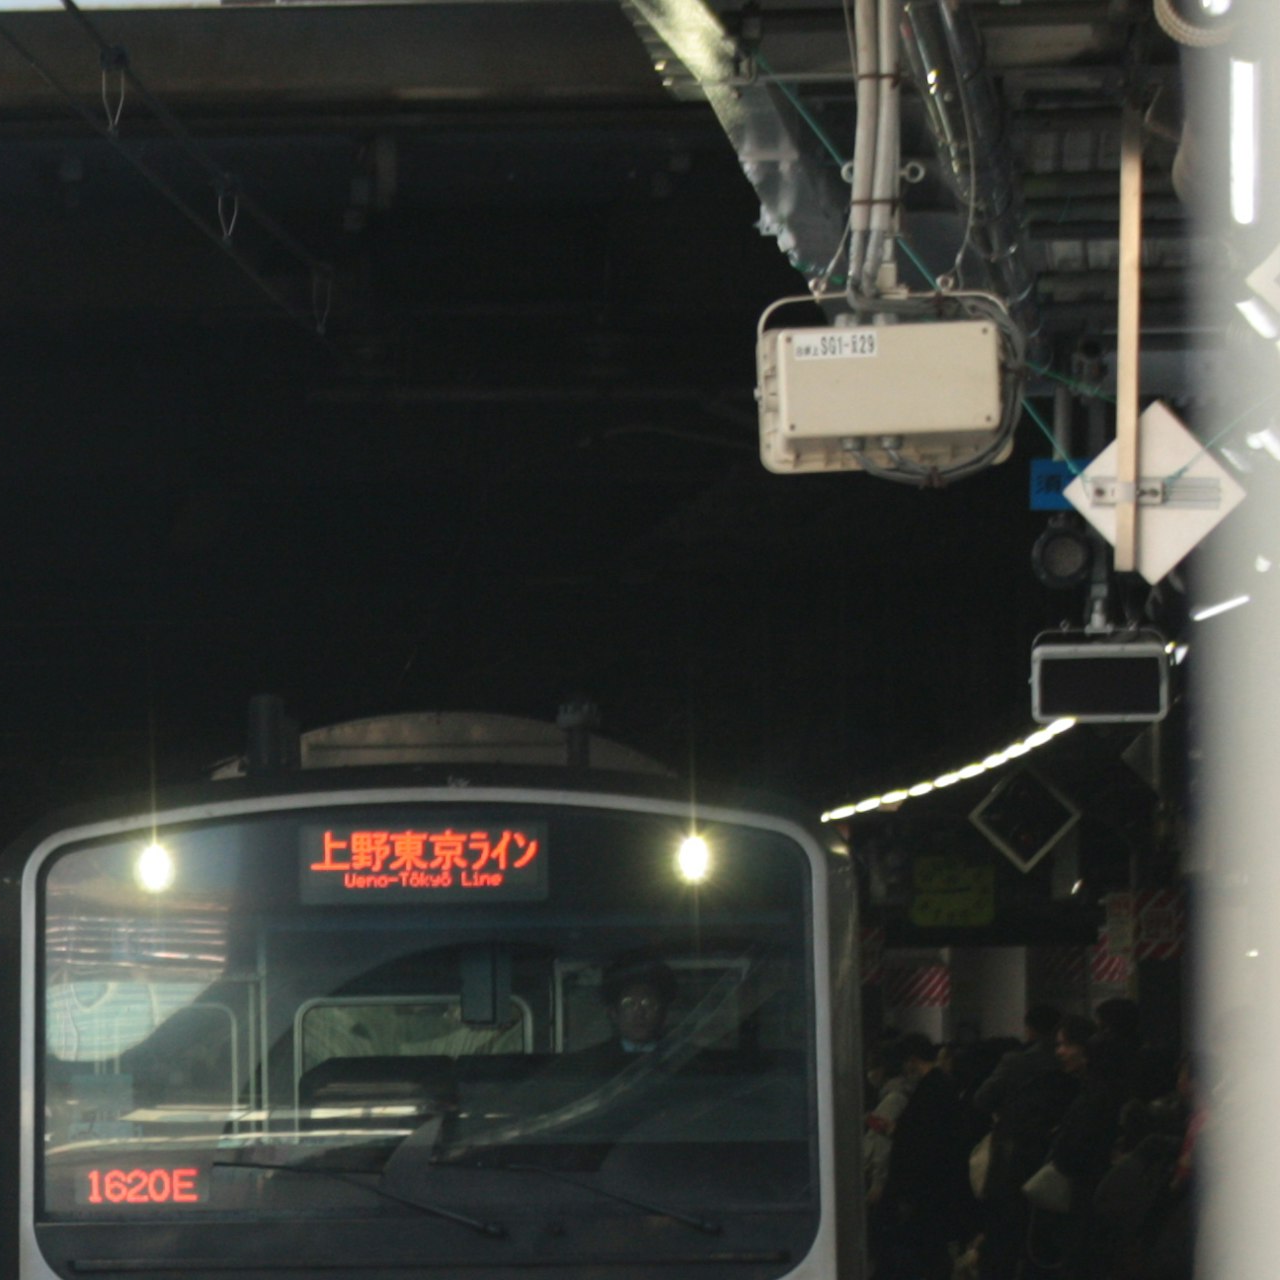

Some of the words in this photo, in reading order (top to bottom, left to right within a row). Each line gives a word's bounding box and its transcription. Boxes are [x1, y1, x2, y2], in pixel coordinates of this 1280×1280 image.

[310, 829, 539, 871] 上野東京ライン
[461, 871, 504, 887] Line
[88, 1168, 199, 1203] 1620E
